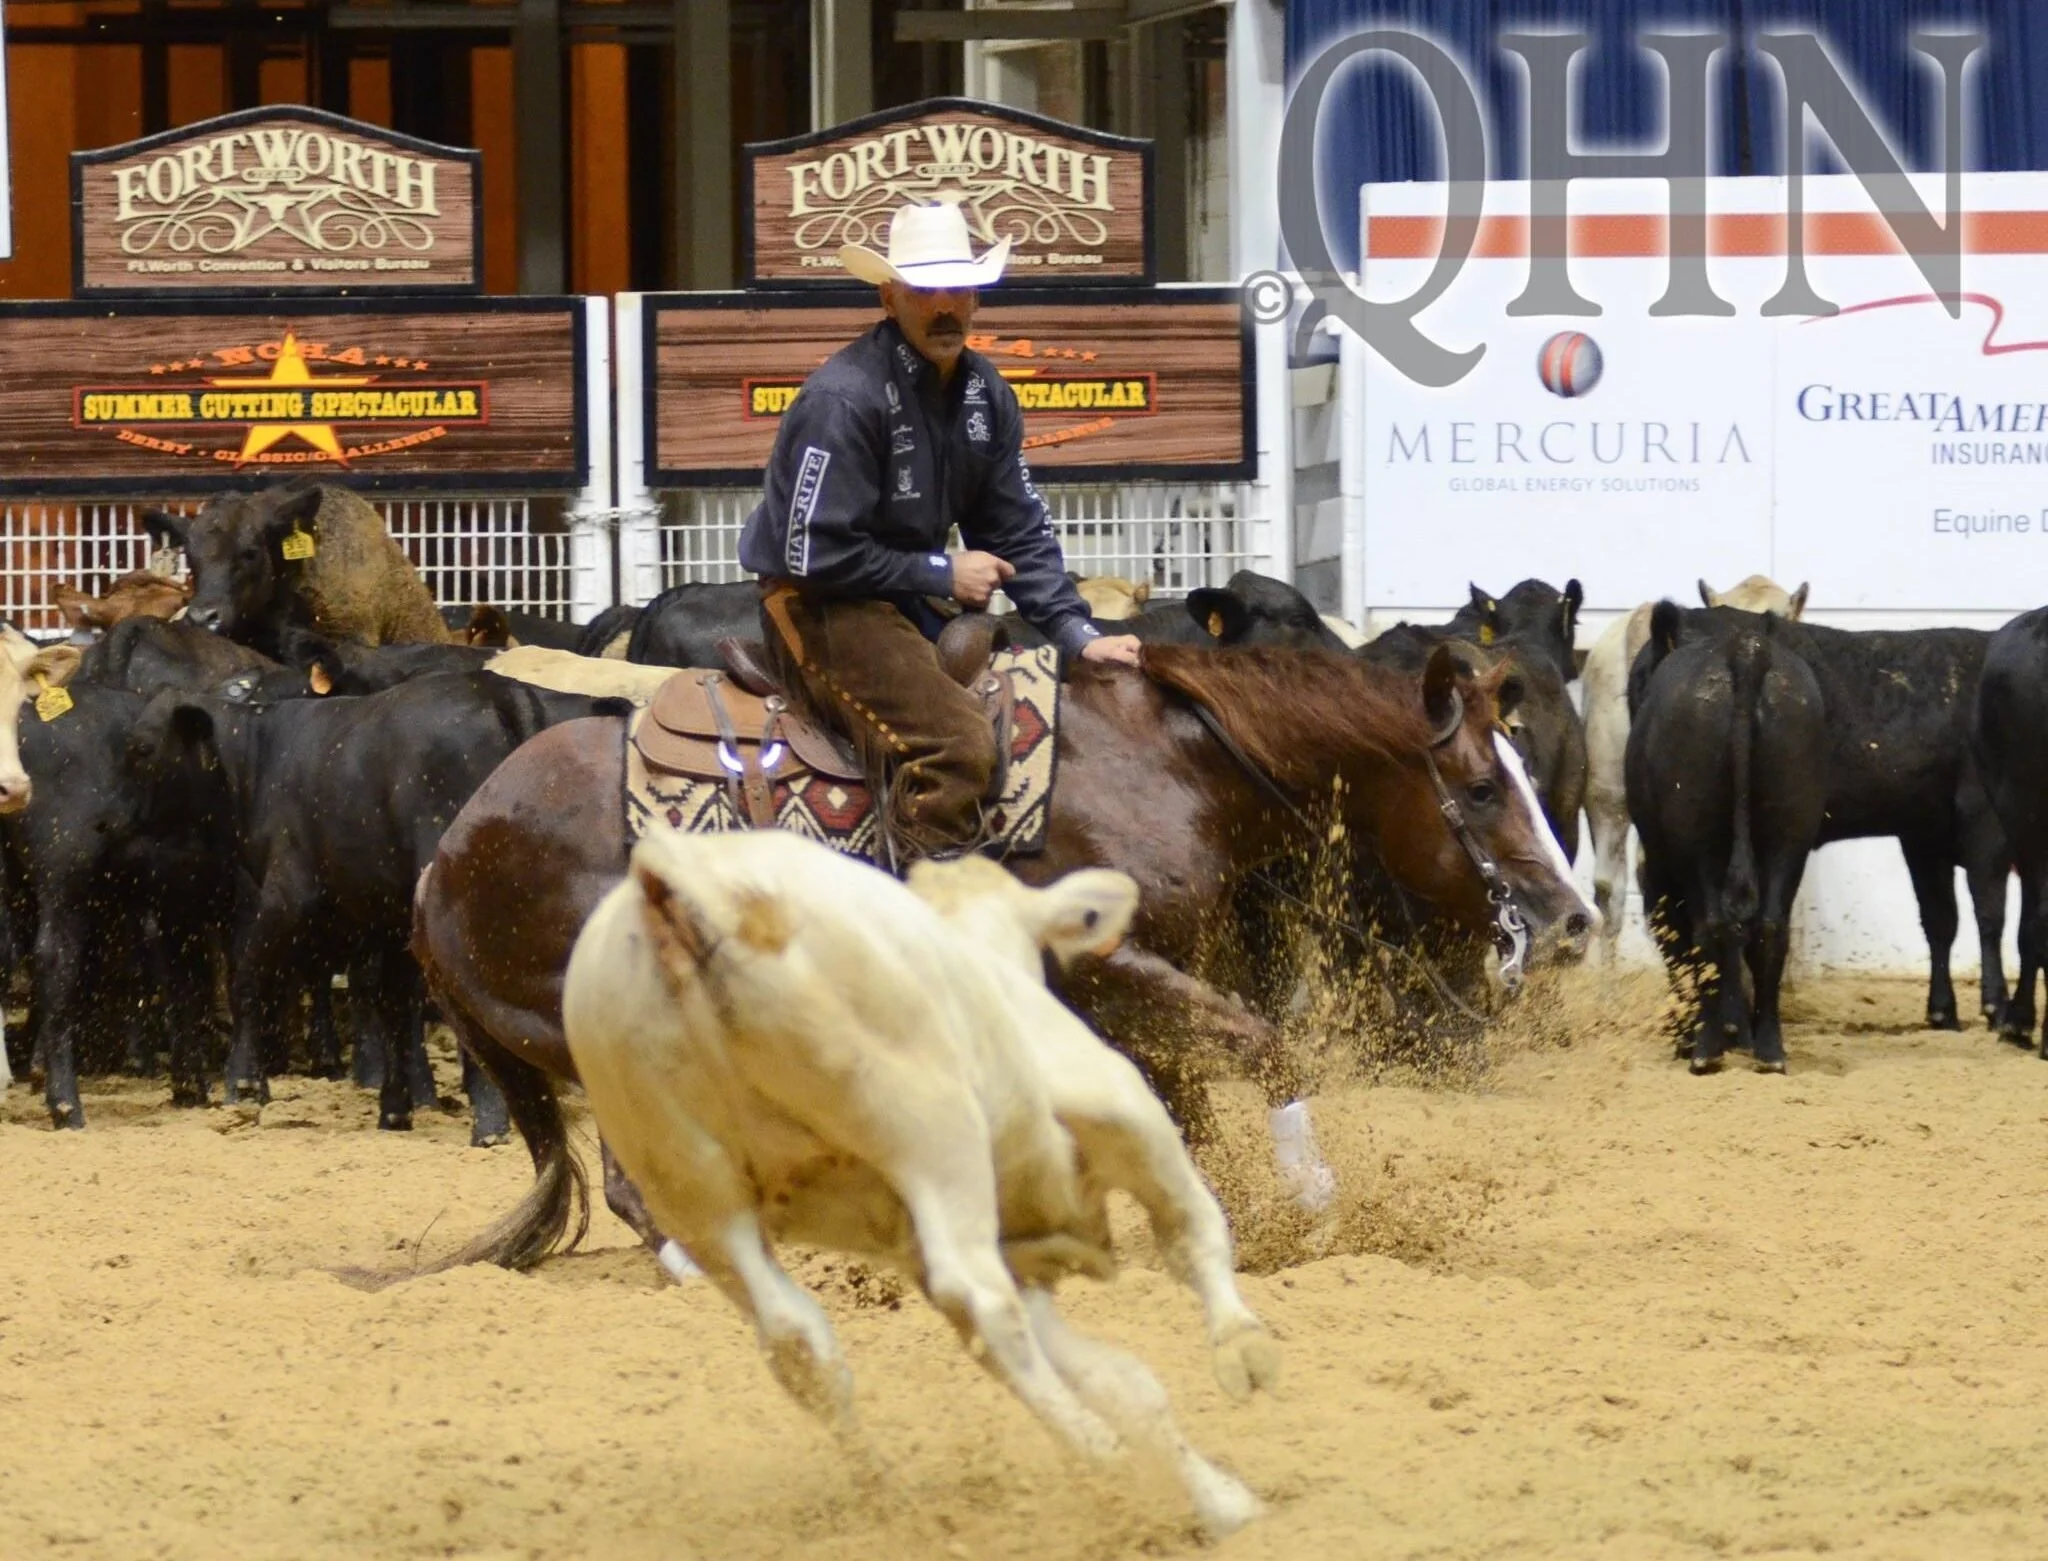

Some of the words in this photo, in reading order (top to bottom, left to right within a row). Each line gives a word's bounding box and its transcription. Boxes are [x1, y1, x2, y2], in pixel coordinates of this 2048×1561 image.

[112, 134, 249, 221] FORT
[248, 129, 440, 217] WORTH
[786, 129, 921, 217] FORT
[920, 124, 1115, 211] WORTH
[199, 259, 286, 272] Convention
[292, 259, 304, 271] &
[311, 258, 370, 271] Visitors
[374, 257, 430, 270] Bureau
[1047, 253, 1103, 264] Bureau
[84, 394, 193, 419] SUMMER
[201, 393, 304, 418] CUTTING
[311, 391, 478, 418] SPECTACULAR
[1010, 382, 1146, 408] CTACULAR
[116, 429, 192, 456] DERBY
[1386, 421, 1752, 464] MERCURIA
[1931, 442, 2048, 465] INSURAN
[1450, 477, 1518, 492] GLOBAL
[1525, 477, 1593, 492] ENERGY
[1601, 477, 1701, 492] SOLUTIONS
[789, 455, 822, 569] HAY-RITE
[1933, 508, 2031, 539] Equine
